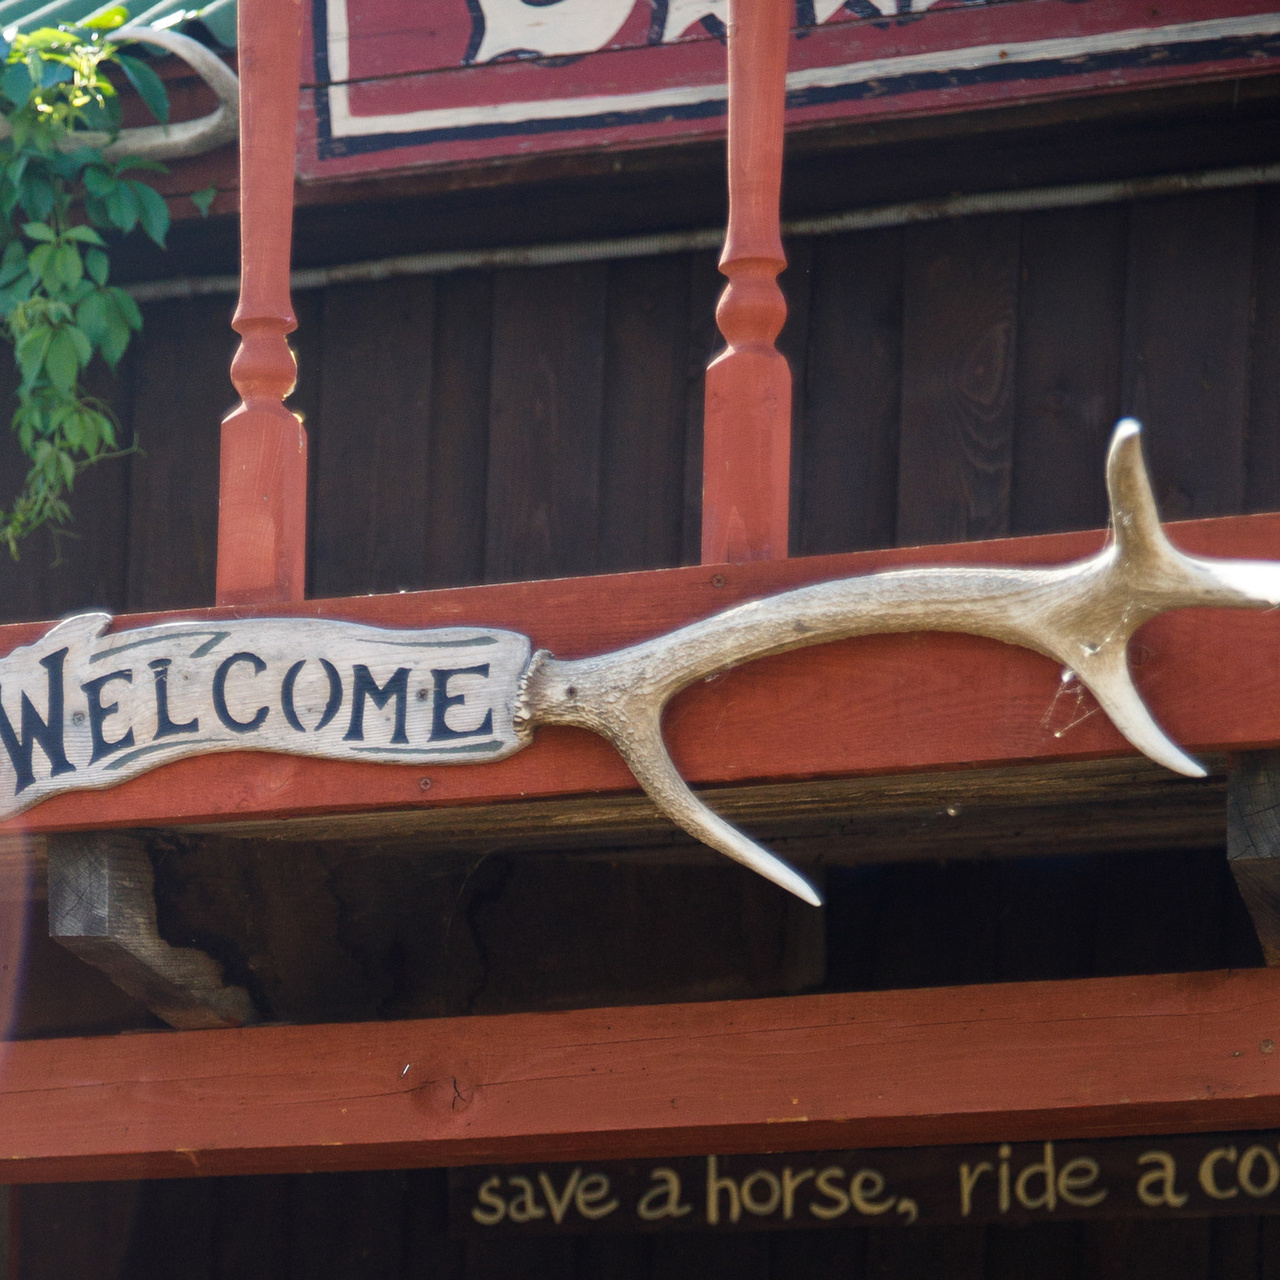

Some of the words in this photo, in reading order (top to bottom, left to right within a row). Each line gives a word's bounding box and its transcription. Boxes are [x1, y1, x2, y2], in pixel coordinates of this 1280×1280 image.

[471, 1168, 619, 1225] save
[637, 1166, 692, 1220] a
[706, 1153, 918, 1225] horse,
[958, 1142, 1108, 1216] ride
[1136, 1150, 1189, 1208] a
[1198, 1143, 1280, 1200] co
